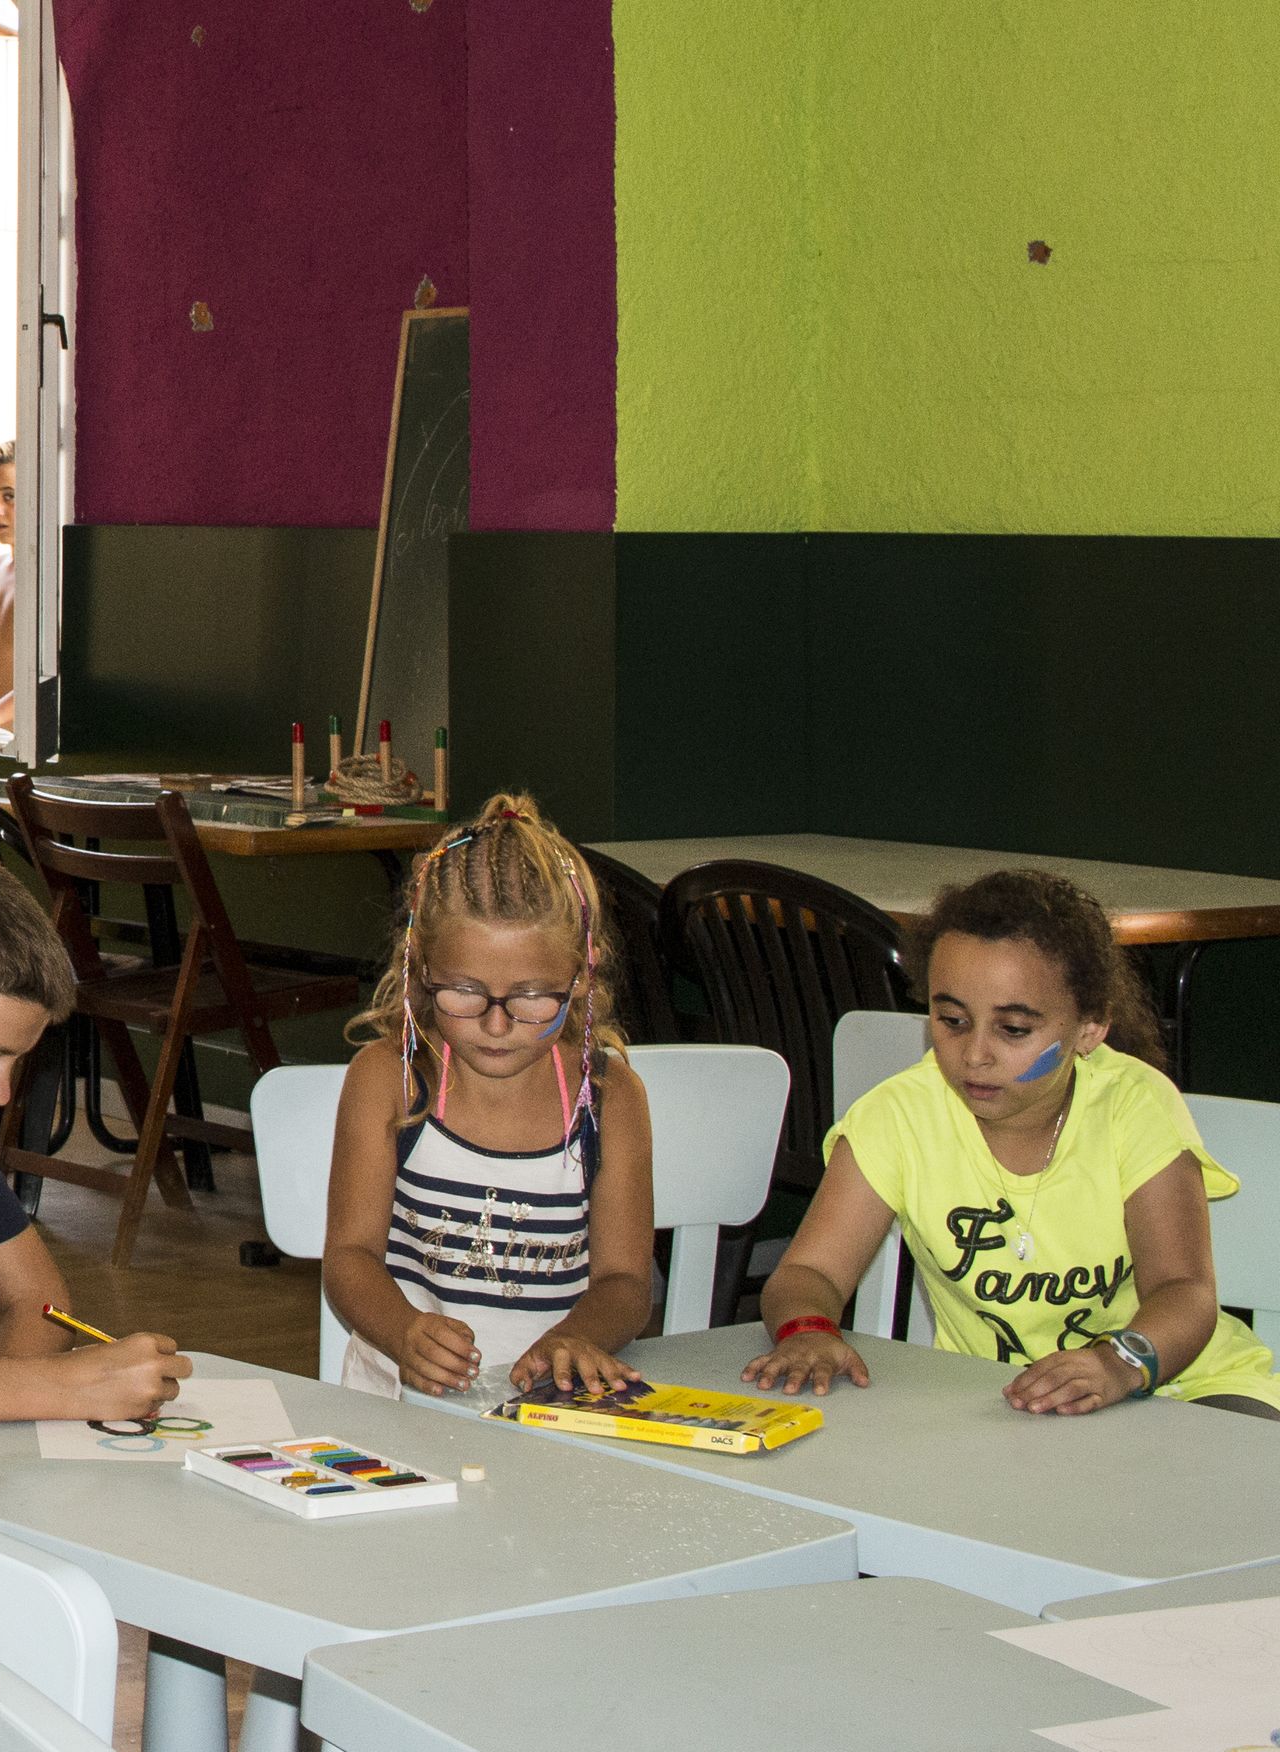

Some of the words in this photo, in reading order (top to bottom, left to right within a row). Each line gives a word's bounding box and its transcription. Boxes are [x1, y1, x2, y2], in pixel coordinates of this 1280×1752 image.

[939, 1198, 1134, 1309] Fancy
[528, 1411, 559, 1422] ALPINO
[711, 1435, 734, 1446] DACS
